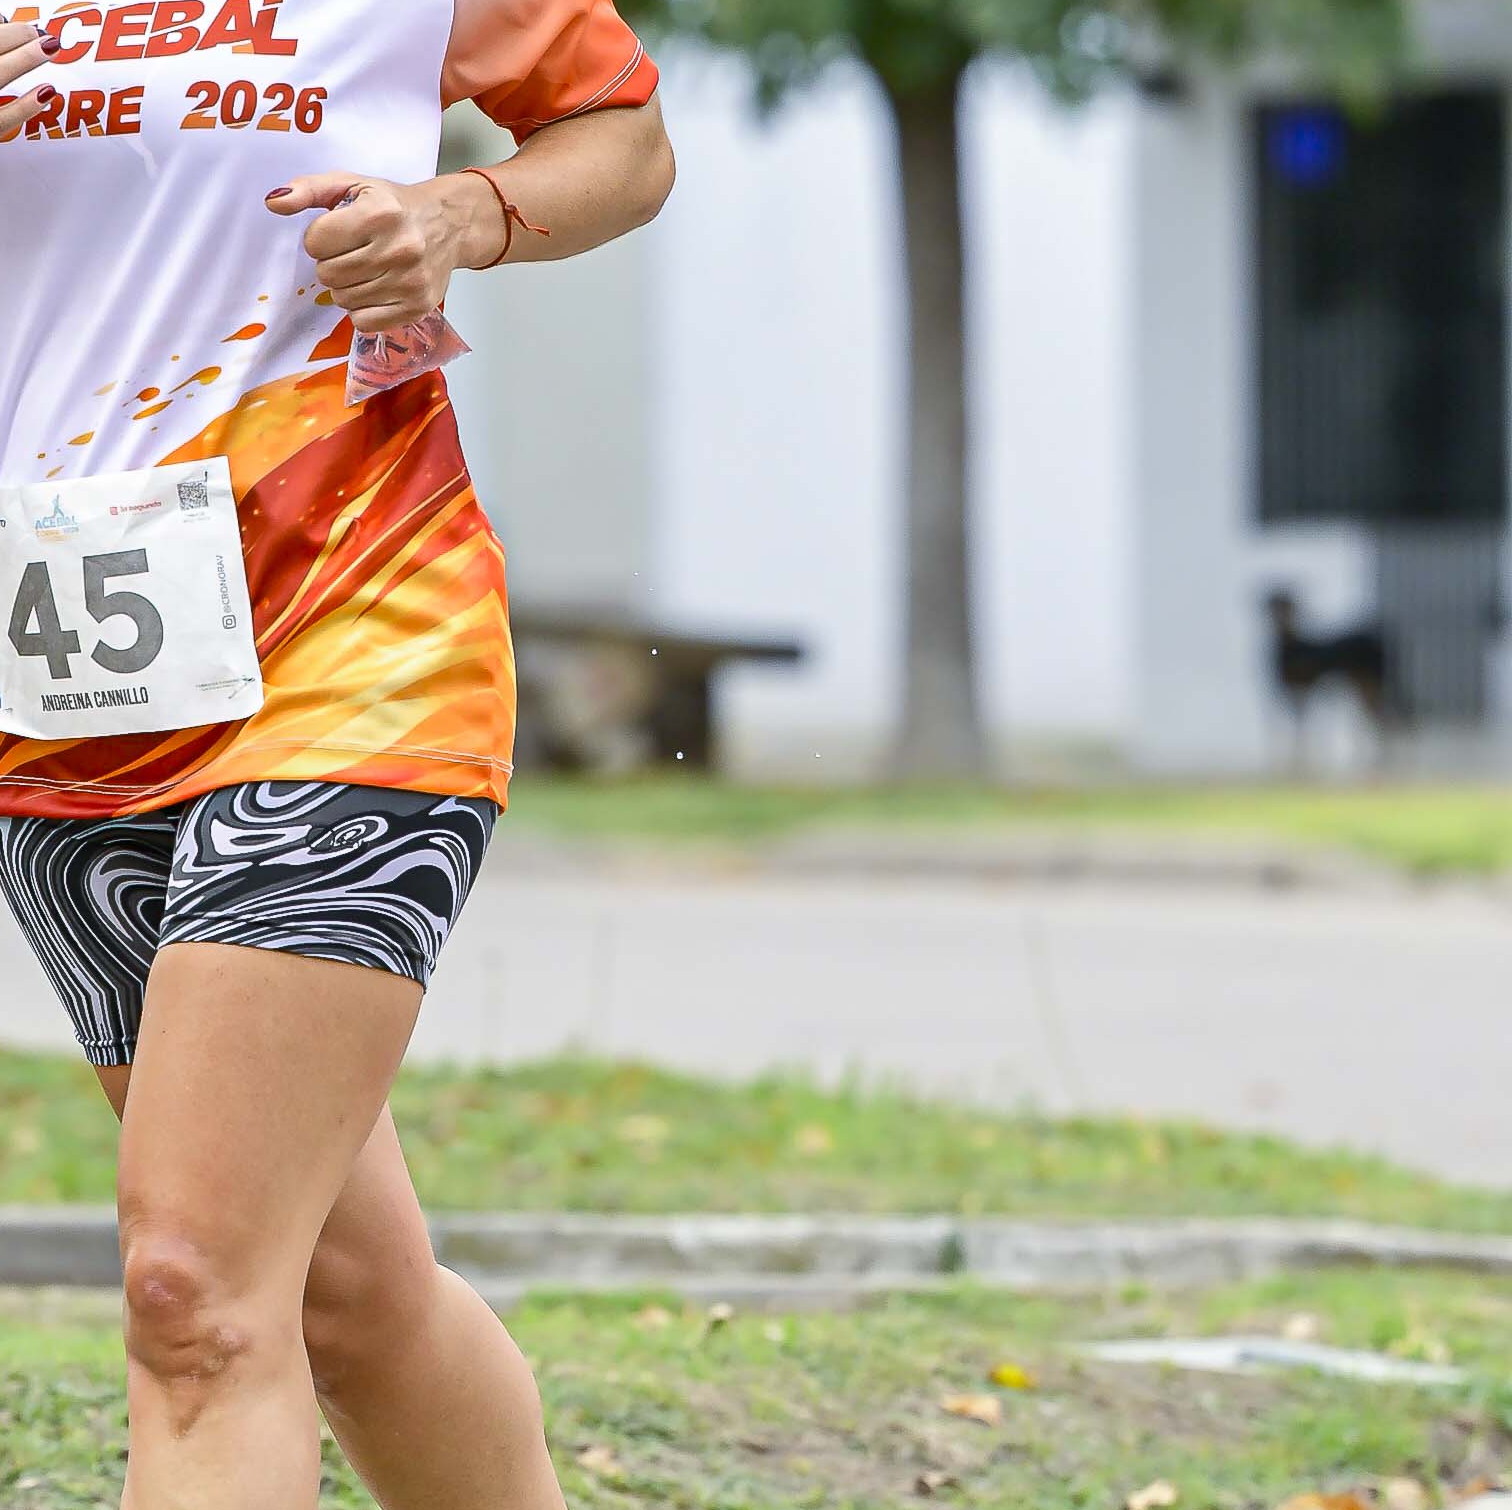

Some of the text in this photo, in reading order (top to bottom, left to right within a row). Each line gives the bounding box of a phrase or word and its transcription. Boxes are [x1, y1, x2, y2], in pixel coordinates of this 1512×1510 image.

[180, 80, 328, 133] 2026
[8, 548, 164, 679] 45
[41, 687, 149, 711] ANDREINA CANNILLO
